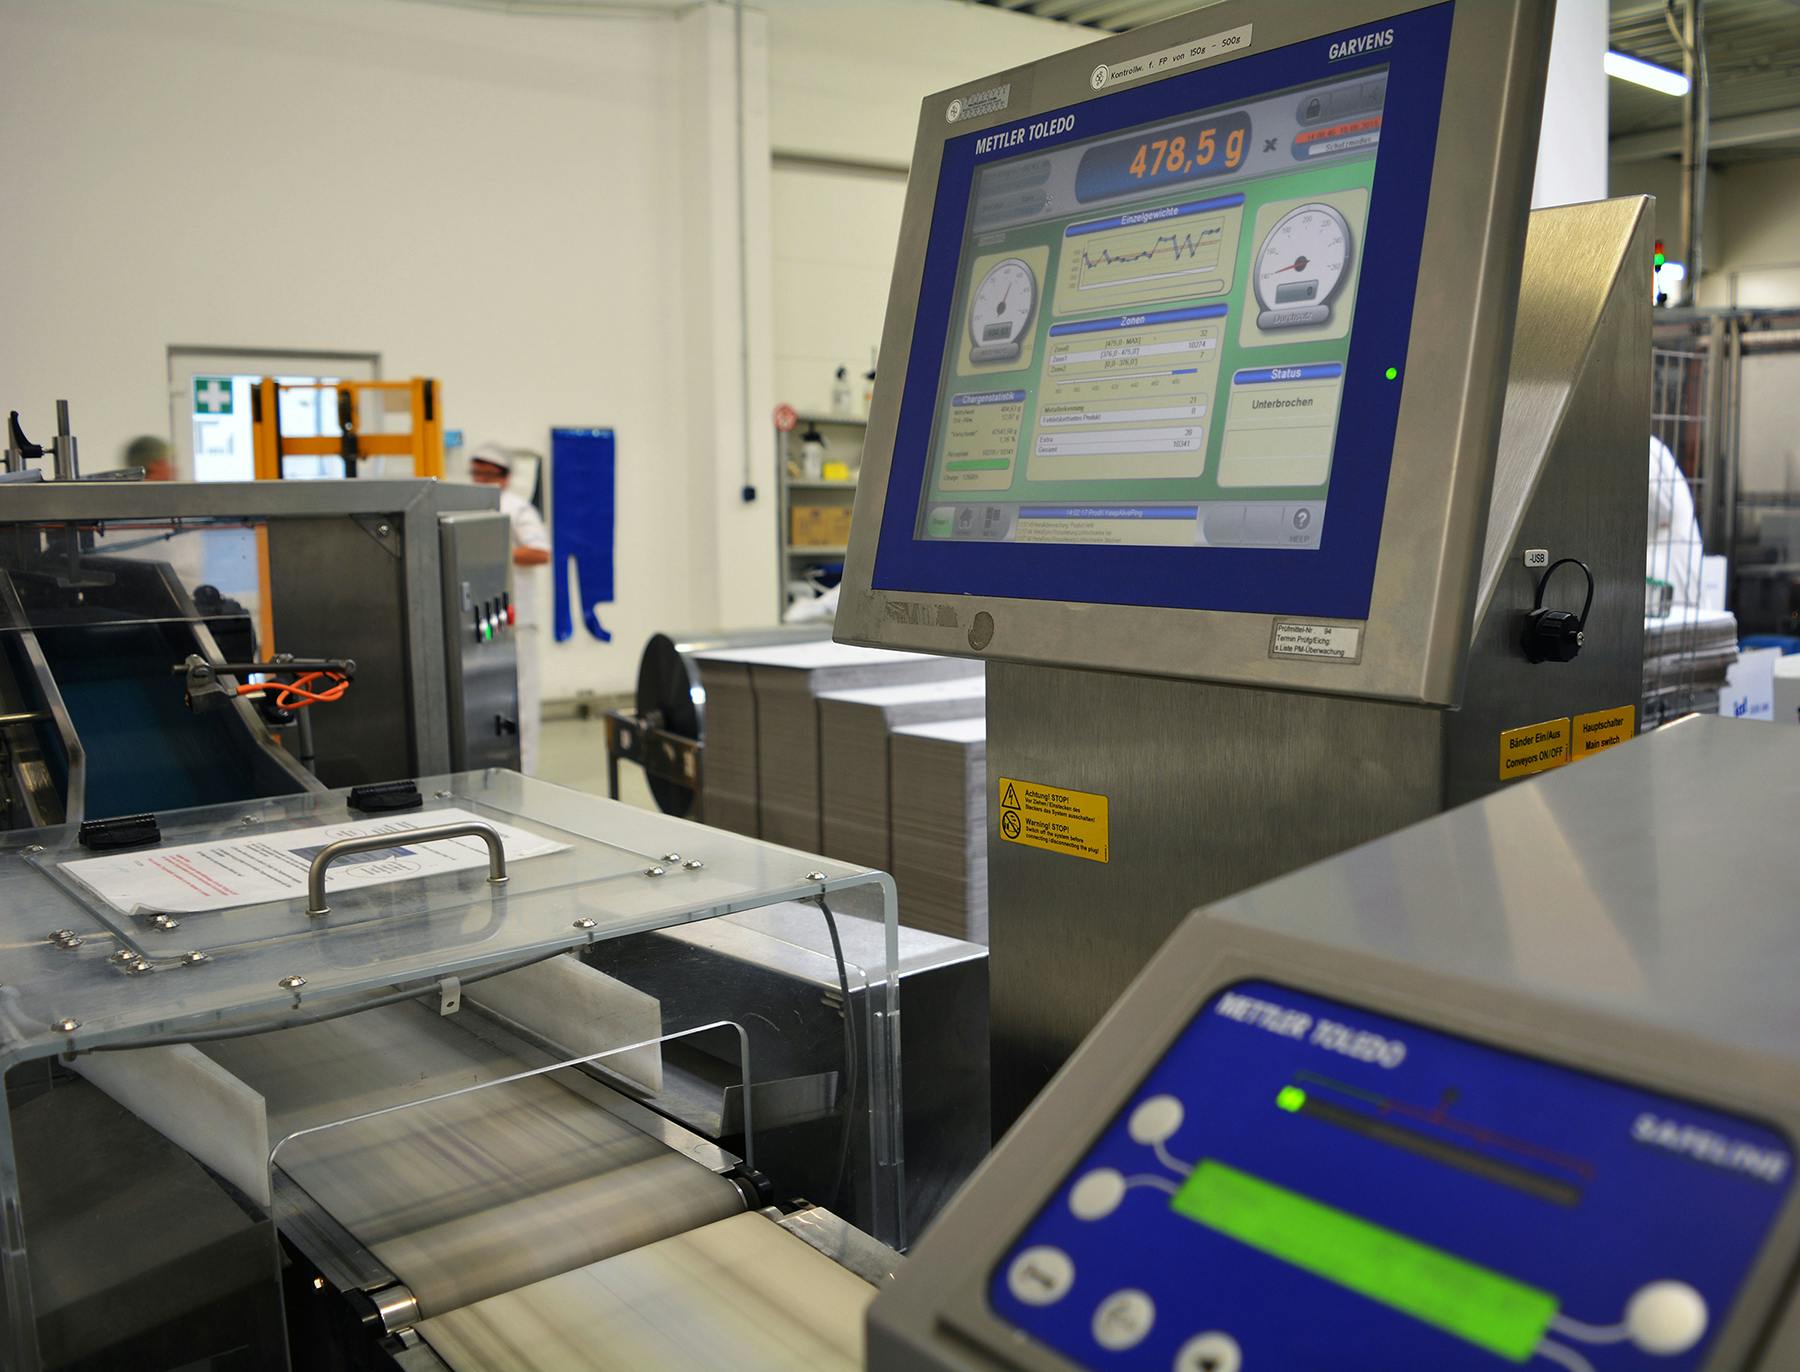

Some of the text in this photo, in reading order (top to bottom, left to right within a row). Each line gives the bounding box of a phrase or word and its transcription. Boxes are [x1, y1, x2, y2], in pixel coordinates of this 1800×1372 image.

[1158, 56, 1168, 66] FP
[1172, 53, 1185, 62] von
[1222, 35, 1241, 47] 500g
[1328, 28, 1394, 60] GARVENS
[975, 114, 1076, 155] METTLER TOLEDO
[1129, 128, 1245, 178] 478,5 g
[1121, 207, 1179, 225] Einzelgewichte
[1121, 315, 1145, 327] Zonen
[1271, 368, 1302, 379] Status
[962, 392, 1015, 405] Chargenstatistik
[1252, 397, 1313, 409] Unterbrochen
[1583, 717, 1624, 734] Hauptschalter
[1509, 734, 1534, 749] Bänder
[1585, 736, 1621, 750] Main switch
[1505, 753, 1538, 769] Conveyors
[1025, 789, 1069, 804] Achtung! STOP!
[1026, 818, 1069, 833] Warning! STOP!
[1215, 991, 1407, 1069] METTLER TOLEDO
